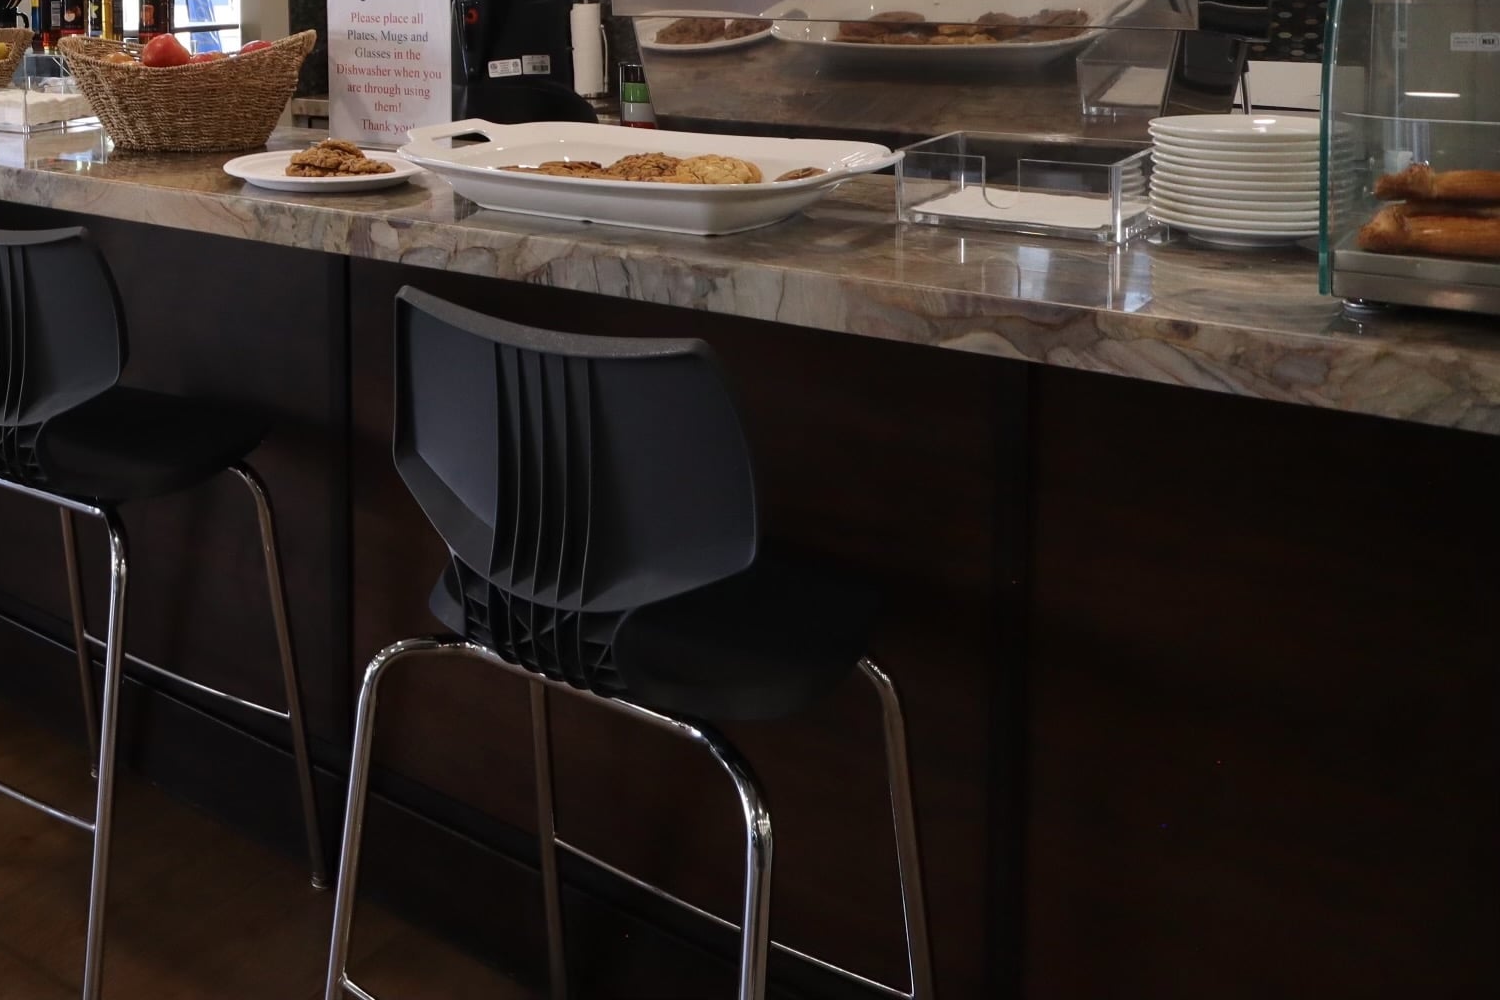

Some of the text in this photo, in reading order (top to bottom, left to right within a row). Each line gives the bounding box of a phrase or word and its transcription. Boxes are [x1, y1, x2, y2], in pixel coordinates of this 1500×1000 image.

[351, 12, 424, 26] Please place all
[347, 30, 429, 45] Plates, Mugs and
[355, 47, 421, 61] Glasses in the
[336, 64, 442, 81] Dishwasher when you
[347, 82, 430, 100] are through using
[374, 102, 402, 113] them!
[361, 119, 390, 131] Thank
